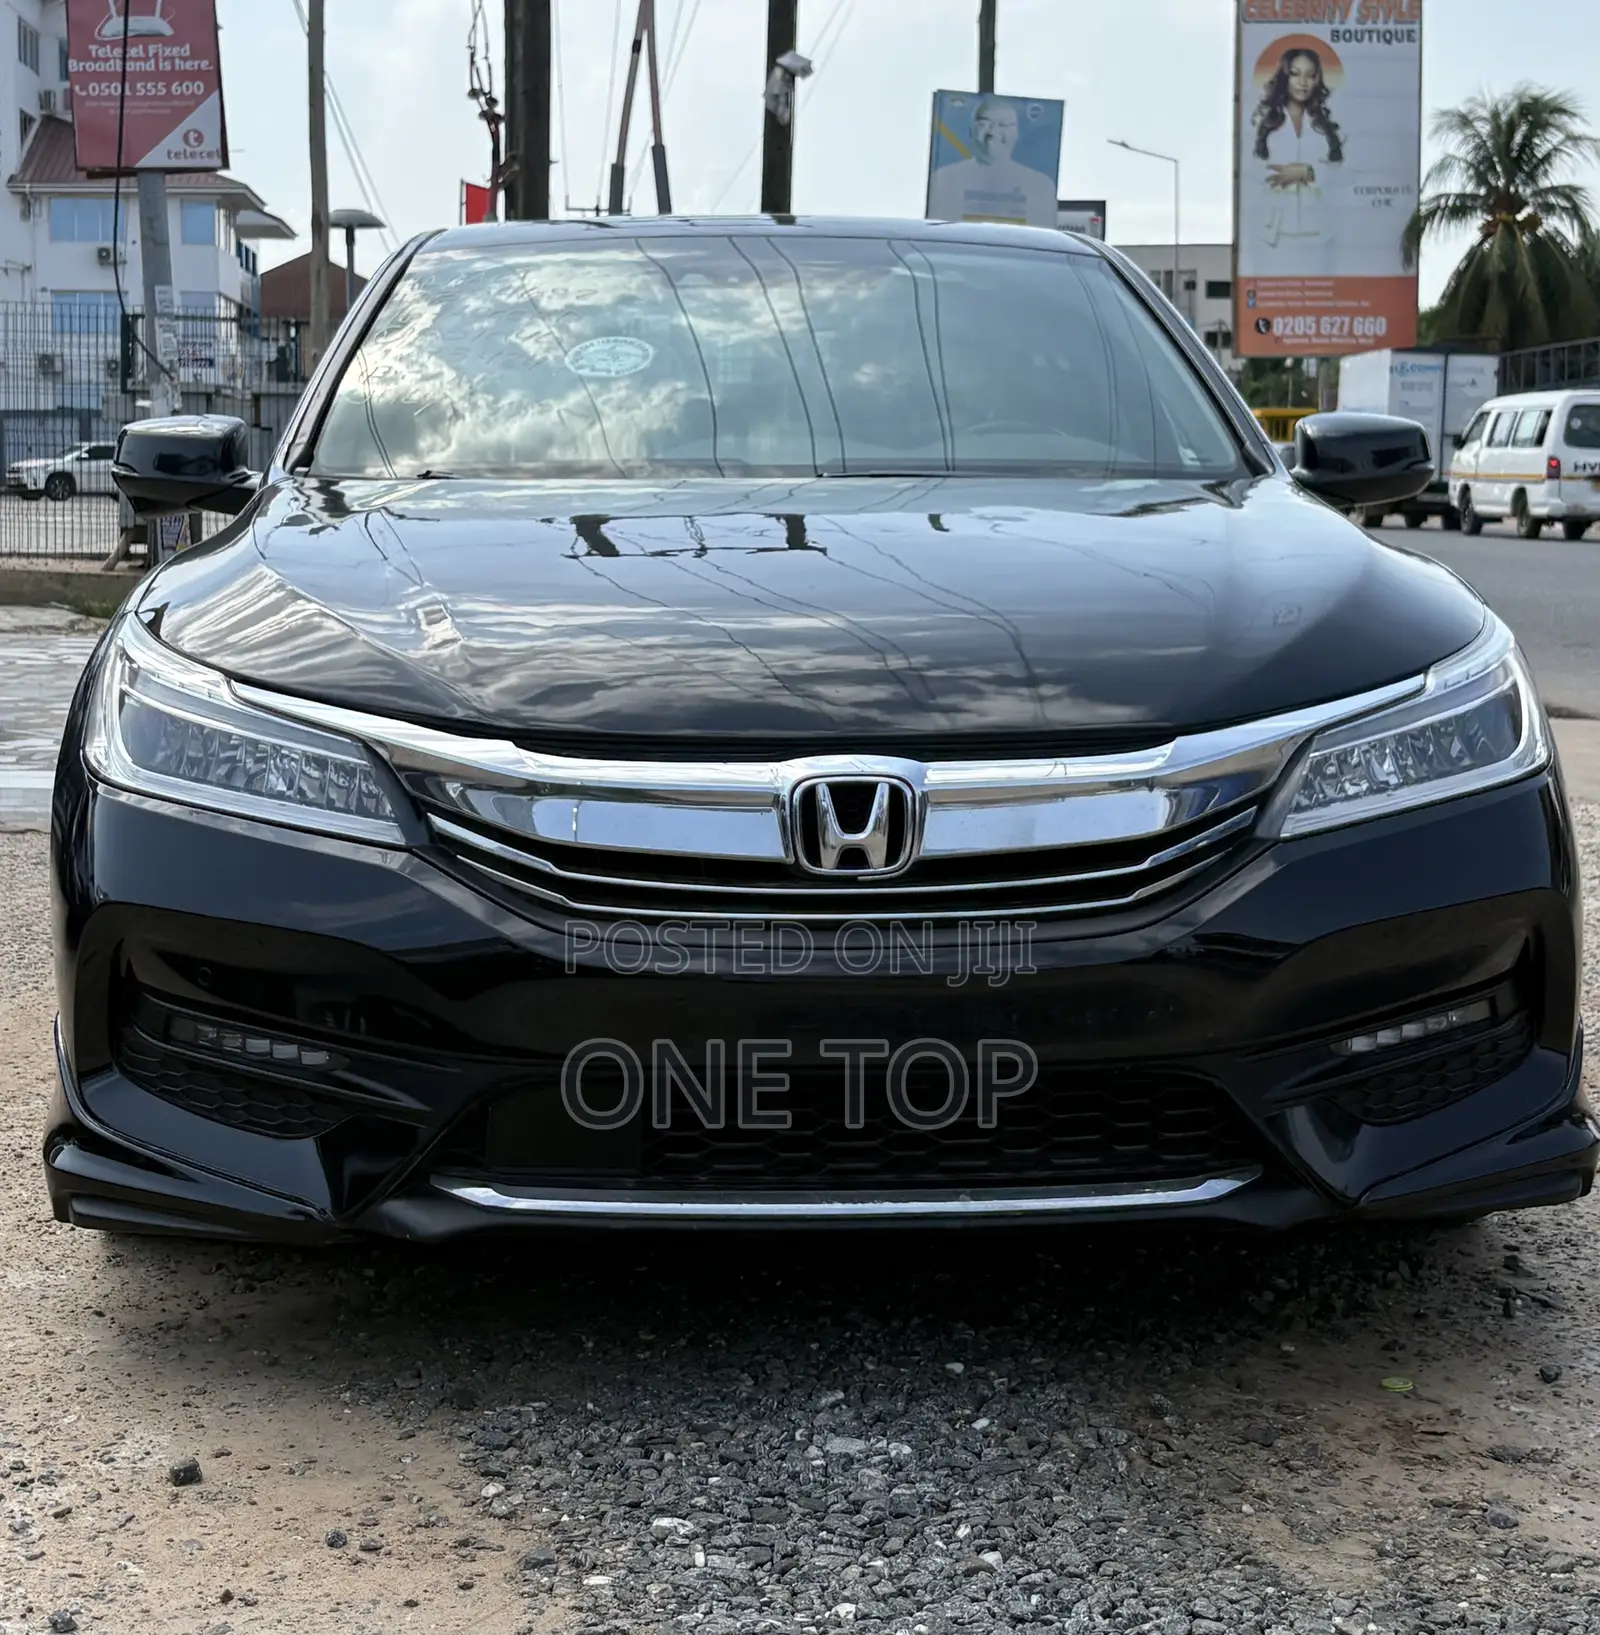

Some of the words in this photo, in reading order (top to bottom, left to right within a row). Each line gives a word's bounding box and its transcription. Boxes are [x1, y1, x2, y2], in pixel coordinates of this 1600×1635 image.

[1355, 0, 1420, 23] STYLE
[1330, 29, 1417, 45] BOUTIQUE
[148, 44, 190, 57] Fixed
[68, 58, 155, 72] Broadband
[159, 59, 171, 71] is
[174, 60, 214, 71] here.
[88, 82, 132, 96] 0501
[136, 82, 167, 96] 555
[171, 81, 205, 95] 600
[167, 148, 221, 160] telecel
[1273, 316, 1316, 336] 0205
[1320, 316, 1350, 336] 627
[1353, 316, 1387, 336] 660
[1573, 460, 1600, 473] HY
